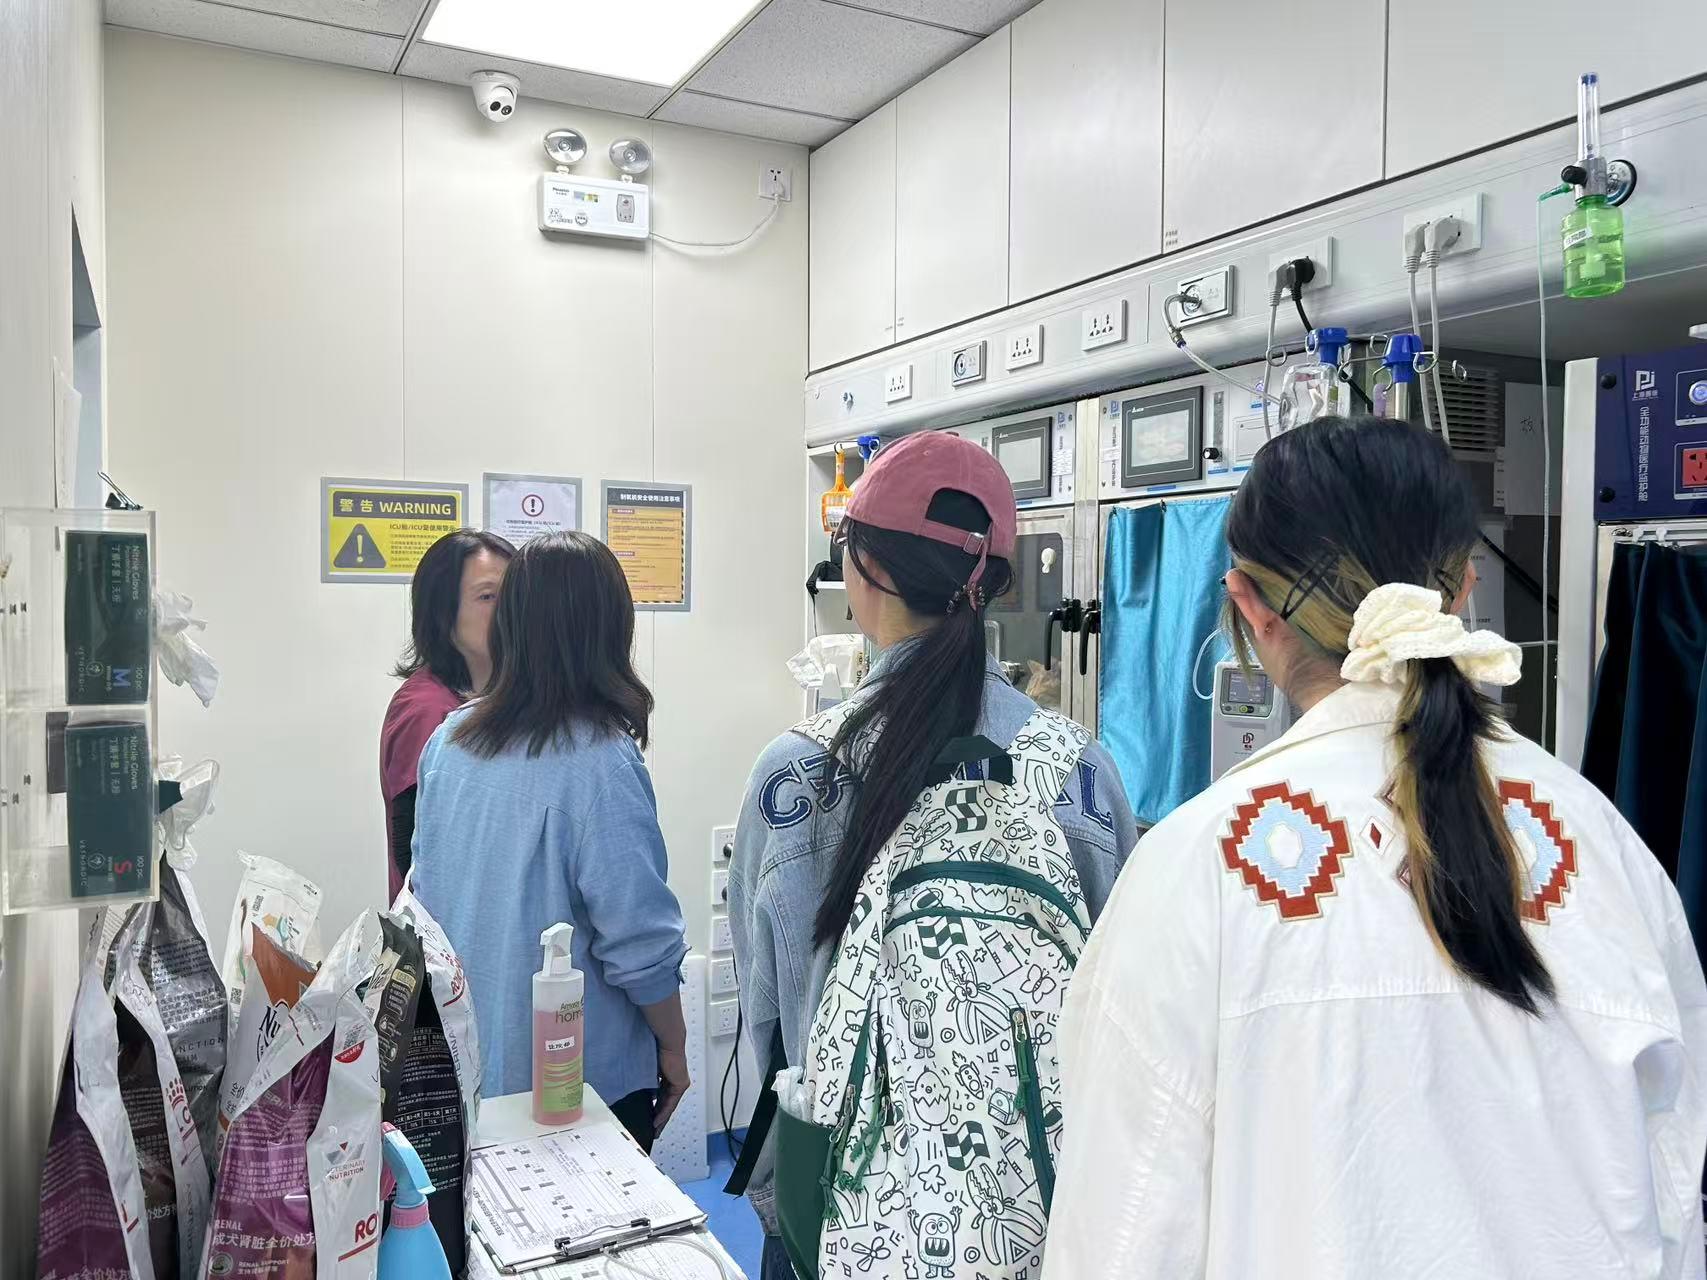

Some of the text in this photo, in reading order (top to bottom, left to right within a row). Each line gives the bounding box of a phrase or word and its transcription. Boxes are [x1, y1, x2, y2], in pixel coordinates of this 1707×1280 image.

[339, 498, 451, 515] 警告 WARNING
[131, 572, 140, 601] Gloves
[112, 668, 131, 687] M
[130, 763, 138, 790] Gloves
[114, 860, 133, 875] S
[179, 1036, 225, 1053] NCTION
[328, 1167, 364, 1181] NUTRITION
[214, 1219, 243, 1231] RENAL
